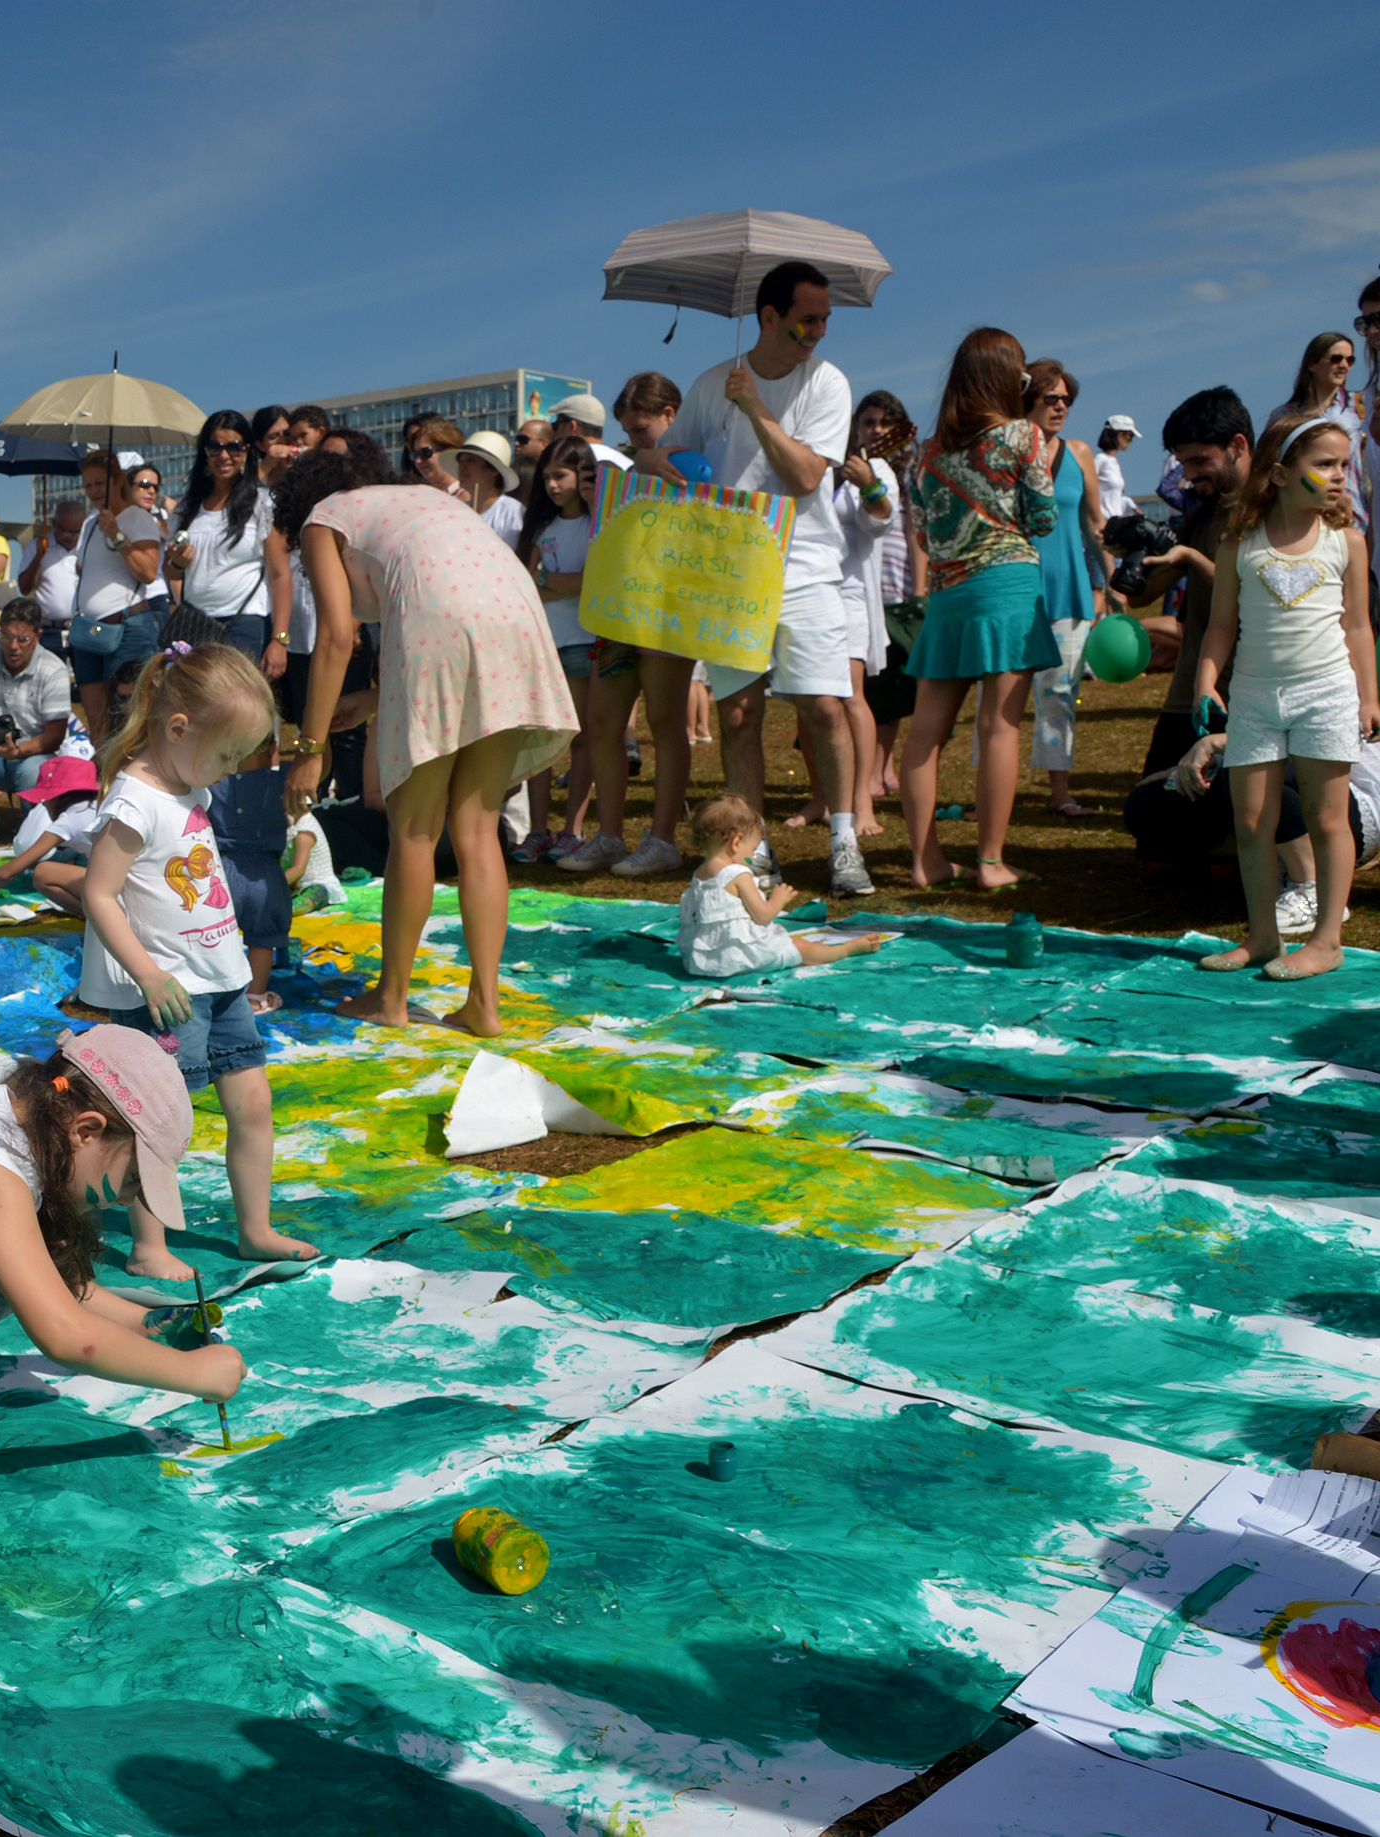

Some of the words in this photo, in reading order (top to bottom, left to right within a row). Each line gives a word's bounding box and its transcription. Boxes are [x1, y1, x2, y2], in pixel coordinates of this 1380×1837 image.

[640, 509, 658, 528] O
[668, 515, 730, 541] FUTURO
[742, 531, 768, 547] DO
[658, 547, 745, 580] BRASIL
[624, 576, 664, 596] QUER
[587, 593, 683, 635] ACORDA
[696, 617, 773, 654] BRASIL
